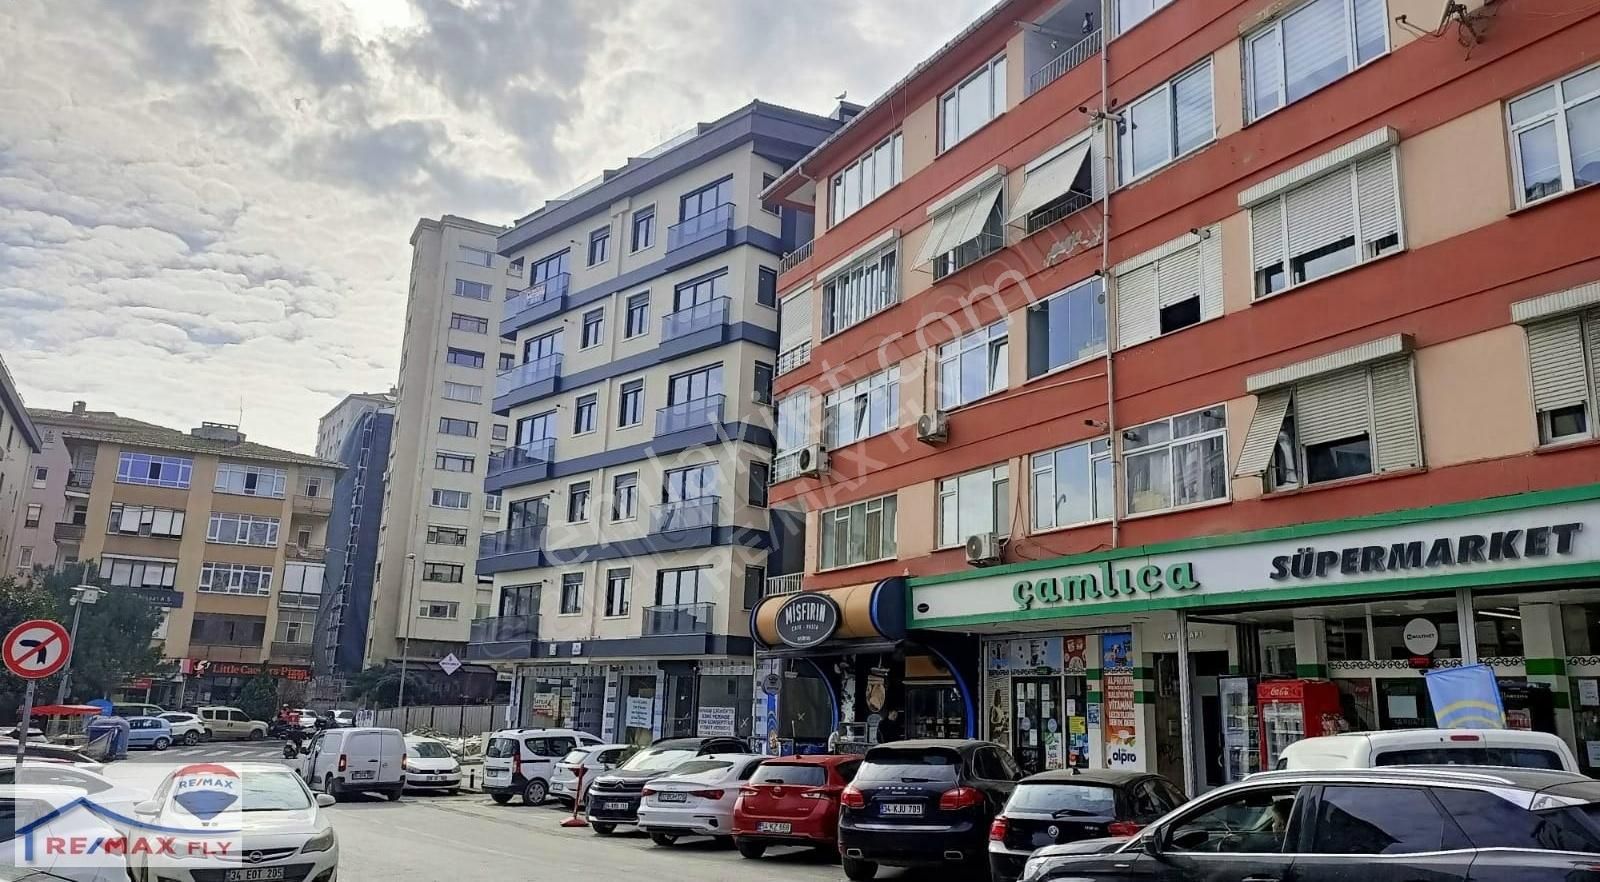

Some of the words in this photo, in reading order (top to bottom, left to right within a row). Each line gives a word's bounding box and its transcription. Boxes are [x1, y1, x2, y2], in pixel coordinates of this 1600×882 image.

[1269, 522, 1583, 580] SÜPERMARKET
[1013, 561, 1200, 610] çamlıca
[213, 663, 240, 674] Little
[1112, 748, 1137, 765] alpro
[231, 870, 241, 881] 34
